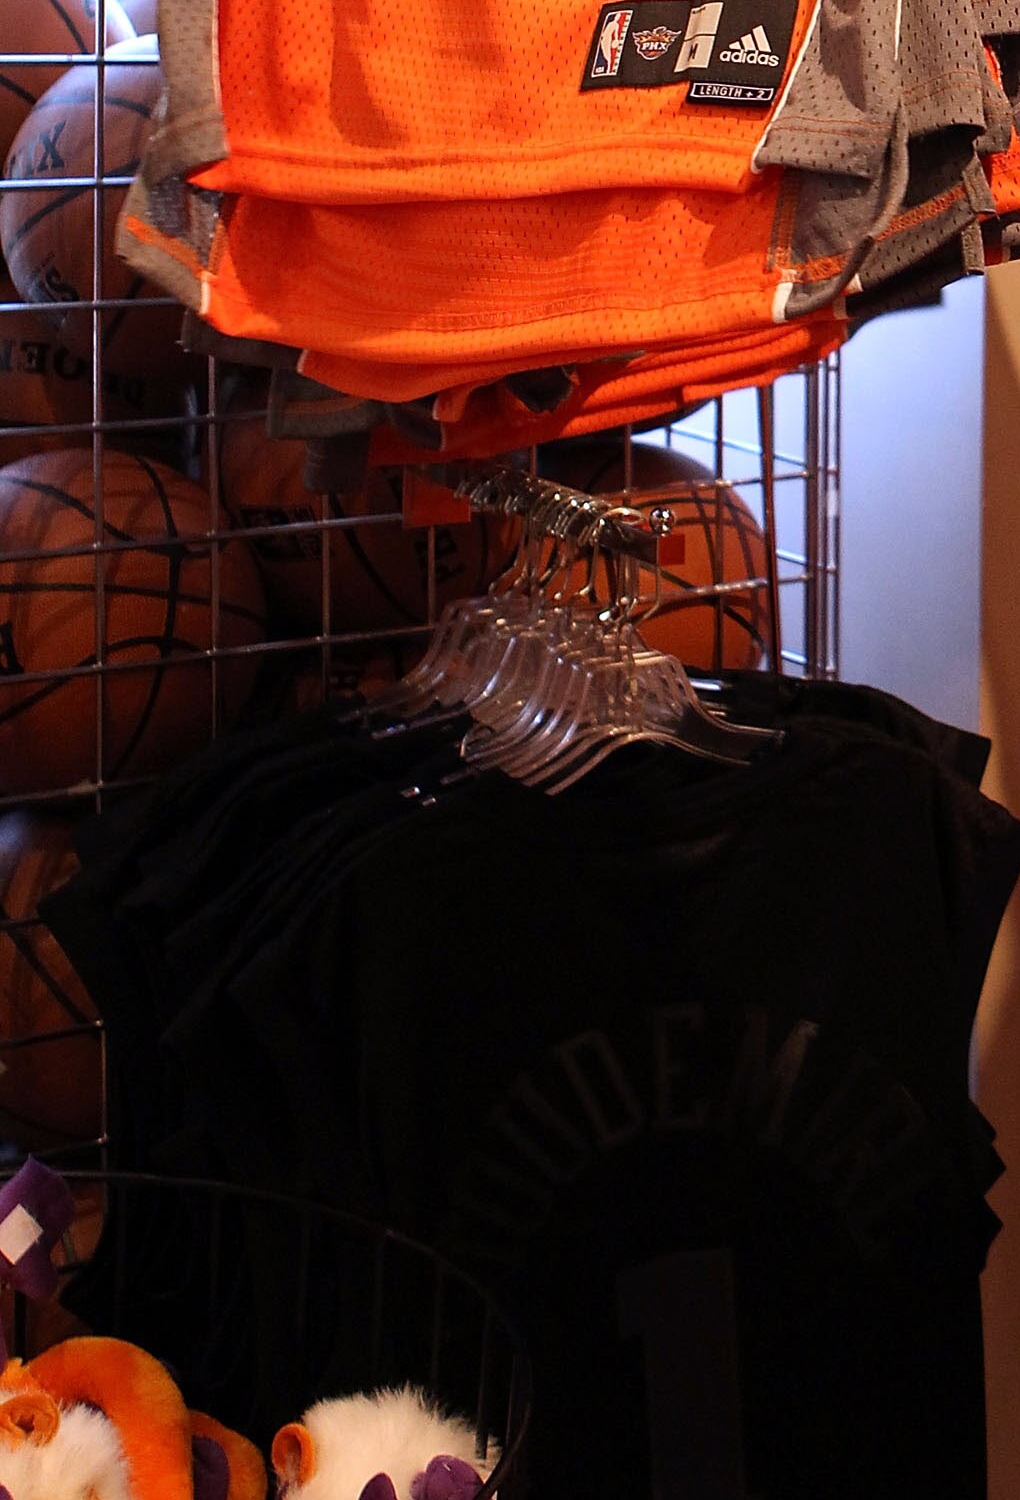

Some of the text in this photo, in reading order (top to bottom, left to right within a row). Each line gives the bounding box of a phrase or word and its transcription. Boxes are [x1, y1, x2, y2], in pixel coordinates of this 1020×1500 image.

[641, 41, 667, 51] PHX
[719, 48, 780, 67] adidas
[700, 85, 742, 98] LENGTH
[756, 90, 765, 99] 2
